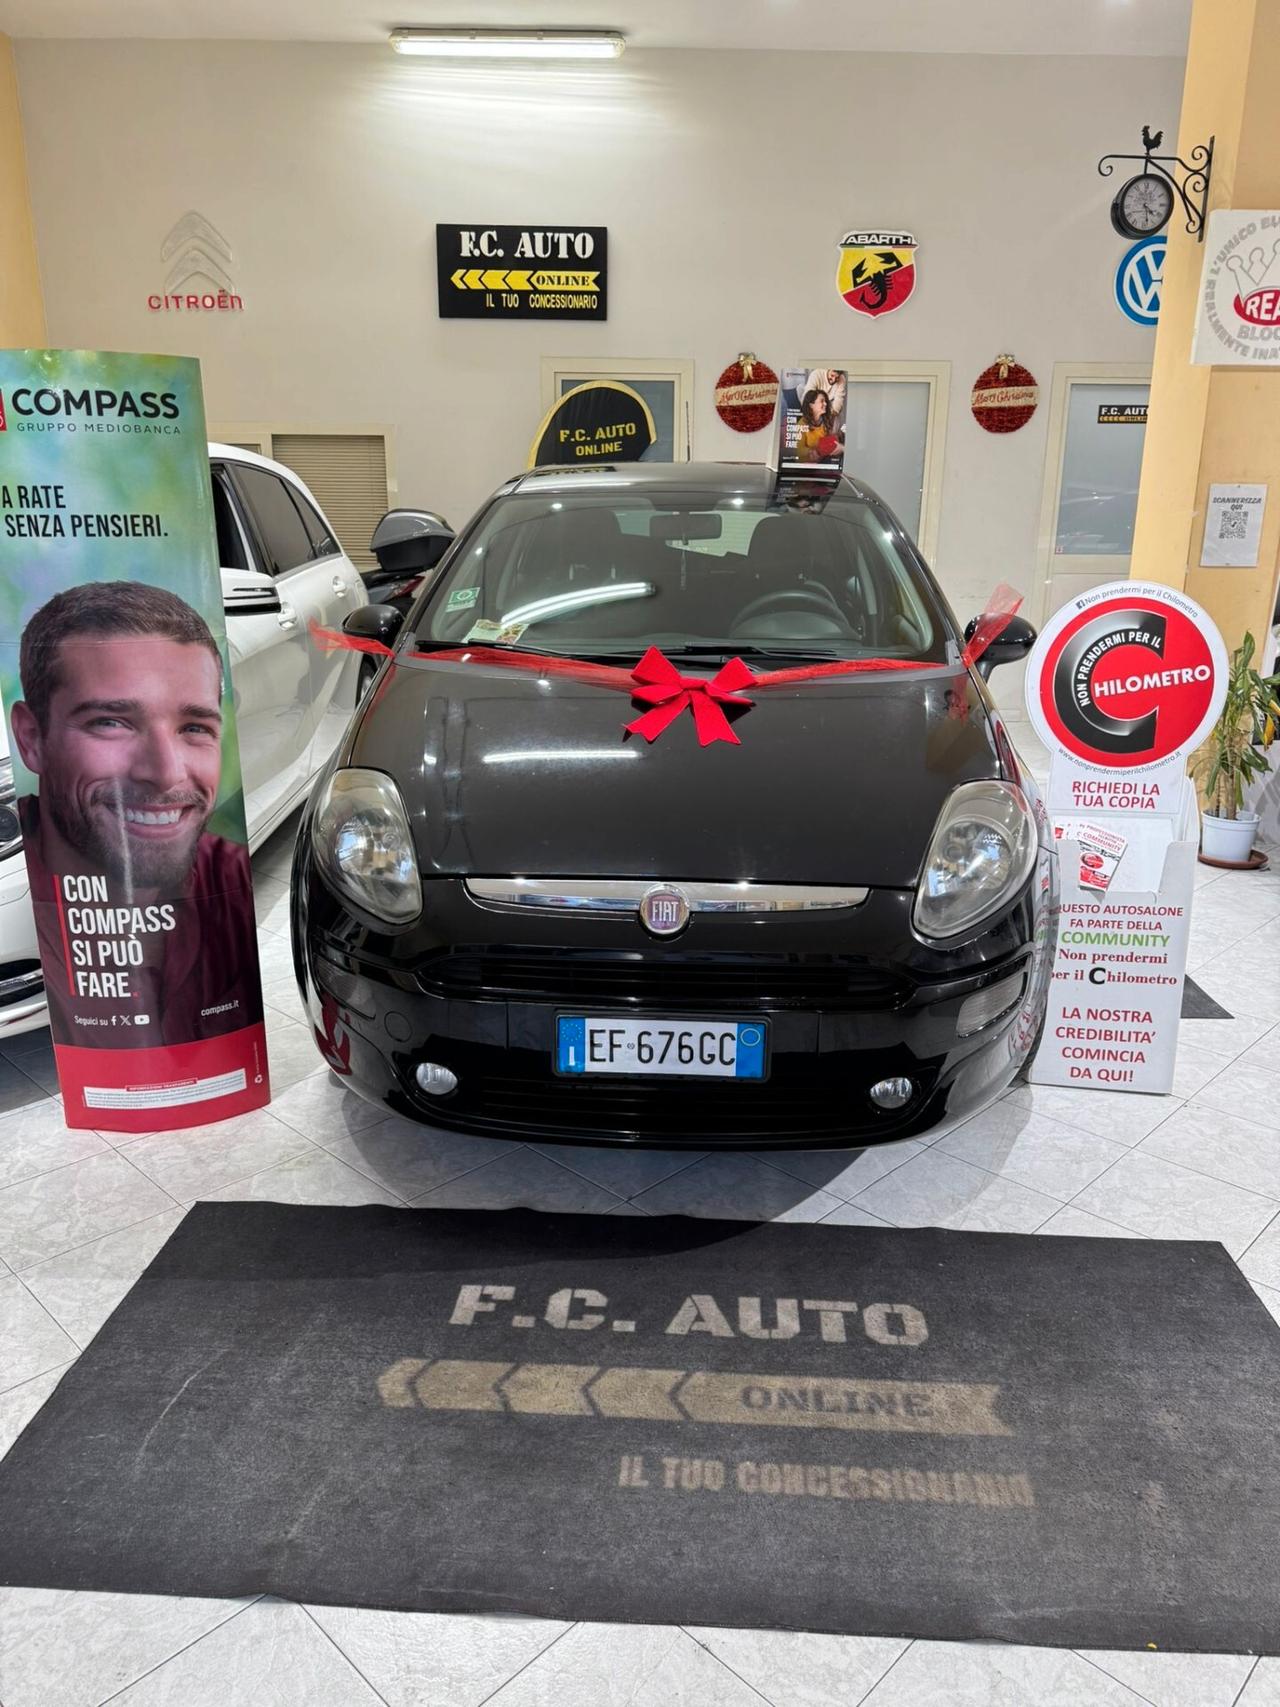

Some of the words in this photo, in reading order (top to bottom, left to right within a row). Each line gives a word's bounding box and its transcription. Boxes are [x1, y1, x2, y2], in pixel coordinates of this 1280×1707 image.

[460, 230, 504, 257] F.C.
[514, 232, 594, 259] AUTO
[845, 234, 912, 244] ABARTH
[1210, 222, 1257, 275] L'UNICO
[536, 274, 591, 286] ONLINE
[485, 293, 495, 307] IL
[501, 293, 519, 308] TUO
[529, 294, 598, 309] CONCESSIONARIO
[1204, 279, 1250, 357] REALMENTE
[1252, 347, 1280, 360] INA
[11, 388, 180, 419] COMPASS
[1101, 407, 1120, 415] F.C.
[1124, 407, 1147, 415] AUT
[17, 422, 77, 433] GRUPPO
[84, 423, 181, 435] MEDIOBANCA
[560, 429, 590, 442] F.C.
[595, 423, 636, 439] AUTO
[576, 441, 622, 456] ONLINE
[1, 486, 13, 508] A
[17, 485, 66, 509] RATE
[5, 514, 66, 538] SENZA
[71, 514, 168, 538] PENSIERI.
[1085, 593, 1101, 607] Non
[1102, 587, 1141, 600] prendermi
[1142, 588, 1157, 597] per
[1163, 591, 1198, 618] Chilometro
[1129, 631, 1149, 642] PER
[1150, 635, 1161, 649] IL
[1077, 633, 1125, 680] PRENDERMI
[1077, 683, 1091, 707] NON
[1072, 781, 1138, 795] RICHIEDI
[1142, 783, 1160, 796] LA
[1073, 795, 1104, 807] TUA
[1109, 796, 1155, 809] COPIA
[63, 874, 109, 902] CON
[652, 900, 679, 922] FIAT
[1059, 903, 1100, 915] UESTO
[1103, 905, 1183, 917] AUTOSALONE
[67, 904, 176, 935] COMPASS
[1070, 918, 1084, 928] FA
[1087, 919, 1123, 930] PARTE
[1127, 921, 1163, 931] DELLA
[1061, 931, 1170, 947] COMMUNITY
[71, 939, 93, 967] SI
[97, 934, 143, 966] PUÒ
[1059, 949, 1087, 961] Non
[1092, 951, 1168, 964] prendermi
[1075, 969, 1084, 981] il
[1089, 967, 1177, 985] Chilometro
[200, 999, 239, 1018] compass.it
[1062, 1007, 1081, 1019] LA
[1087, 1008, 1153, 1023] NOSTRA
[74, 1014, 98, 1026] Seguici
[99, 1017, 108, 1026] su
[1061, 1046, 1146, 1063] COMINCIA
[1070, 1066, 1092, 1079] DA
[1097, 1067, 1134, 1082] QUI!
[449, 1284, 636, 1332] F.C.
[665, 1294, 930, 1346] AUTO
[739, 1385, 935, 1417] ONLINE
[618, 1455, 649, 1489] IL
[659, 1456, 726, 1492] TUO
